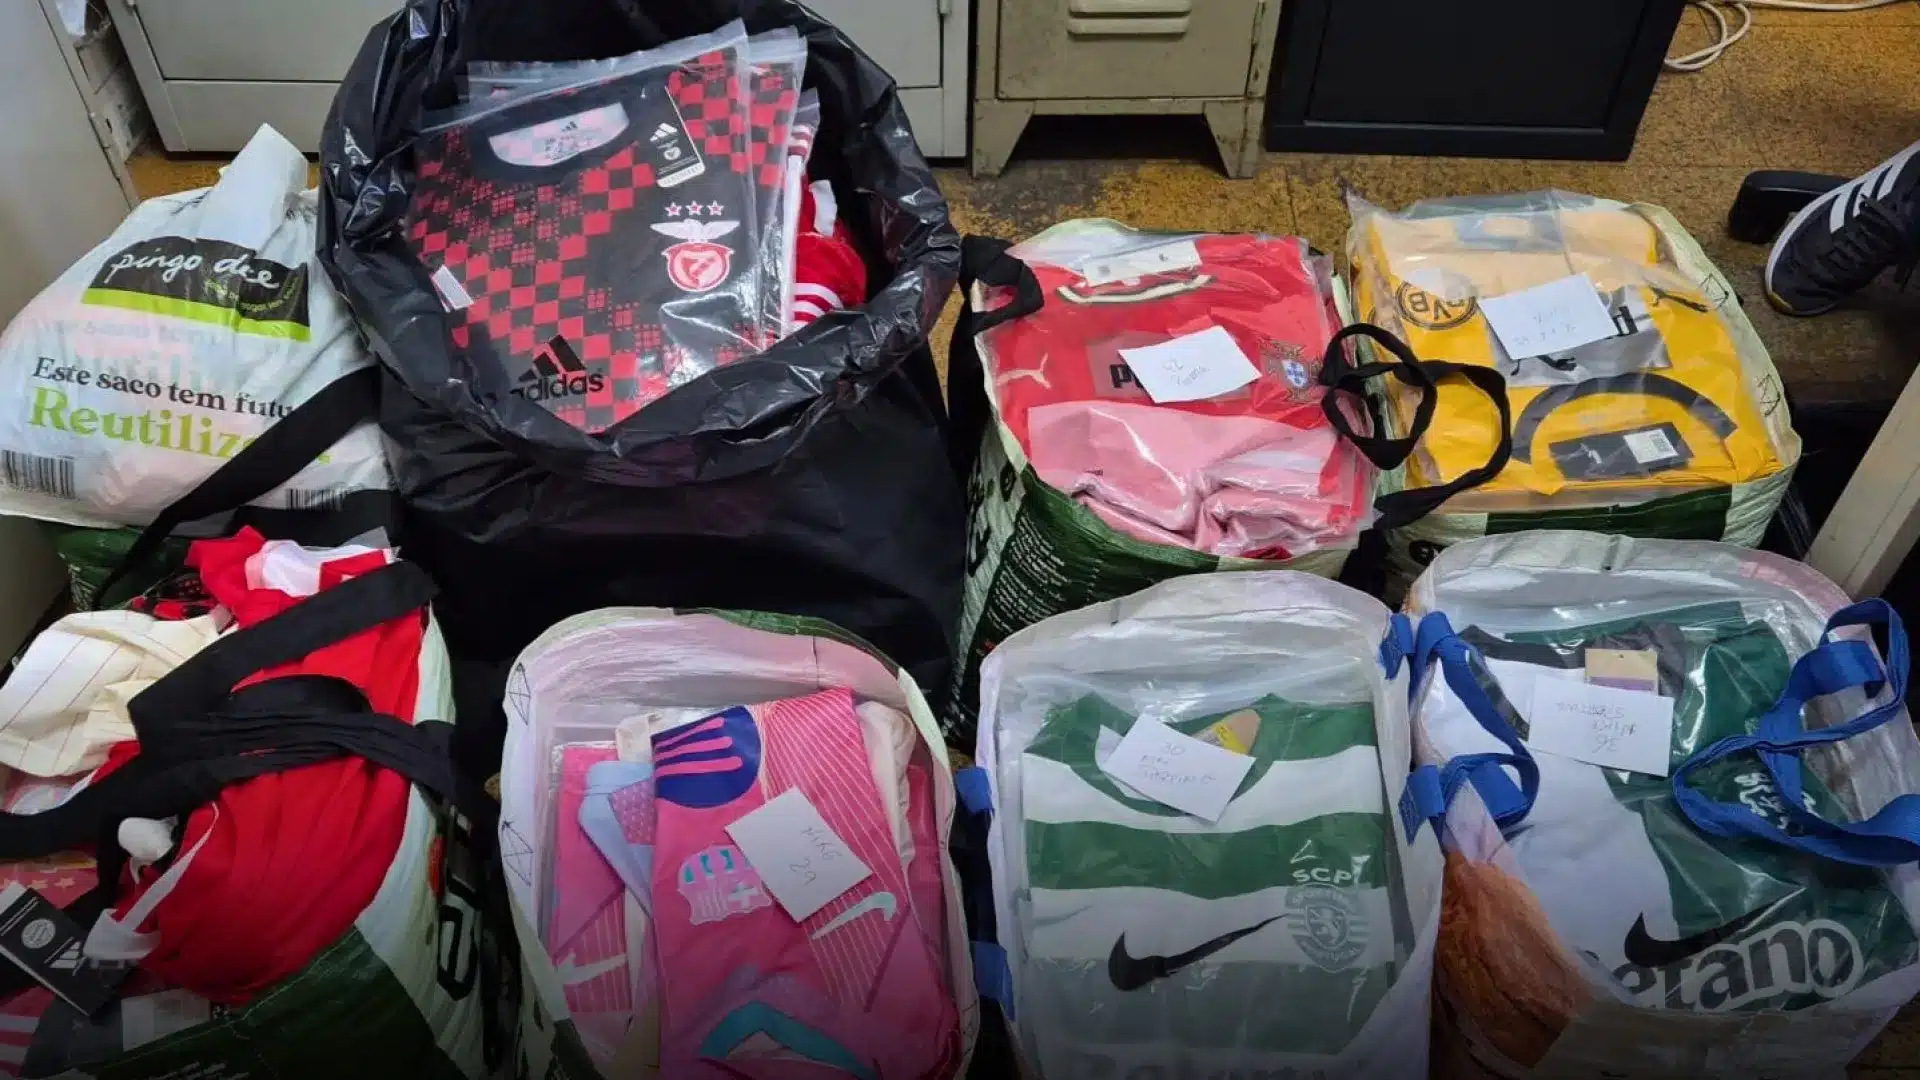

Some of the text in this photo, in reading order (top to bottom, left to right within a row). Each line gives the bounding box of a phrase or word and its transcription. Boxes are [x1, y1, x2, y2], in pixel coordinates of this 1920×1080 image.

[104, 247, 203, 284] pingo
[32, 356, 294, 420] Este saco tem futu
[28, 386, 257, 460] Reutiliz
[1292, 867, 1352, 885] SCP
